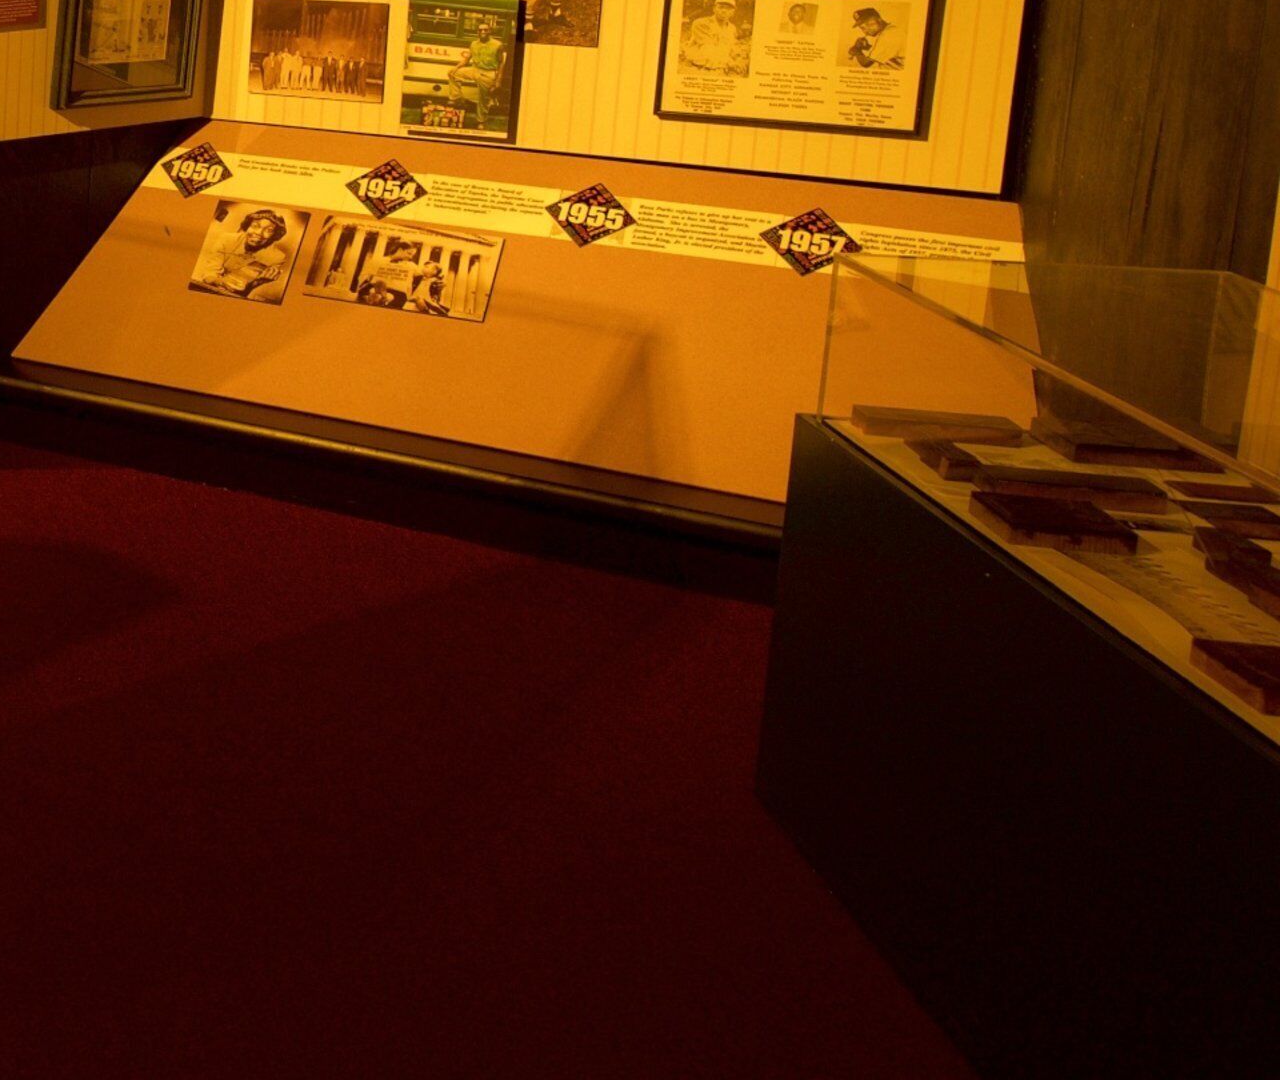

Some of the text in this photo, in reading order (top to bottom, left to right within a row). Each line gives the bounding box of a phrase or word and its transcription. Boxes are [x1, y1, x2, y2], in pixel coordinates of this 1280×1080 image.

[413, 45, 451, 57] BALL
[169, 159, 224, 183] 1950
[356, 177, 417, 202] 1954
[556, 201, 626, 231] 1955
[777, 227, 846, 257] 1957
